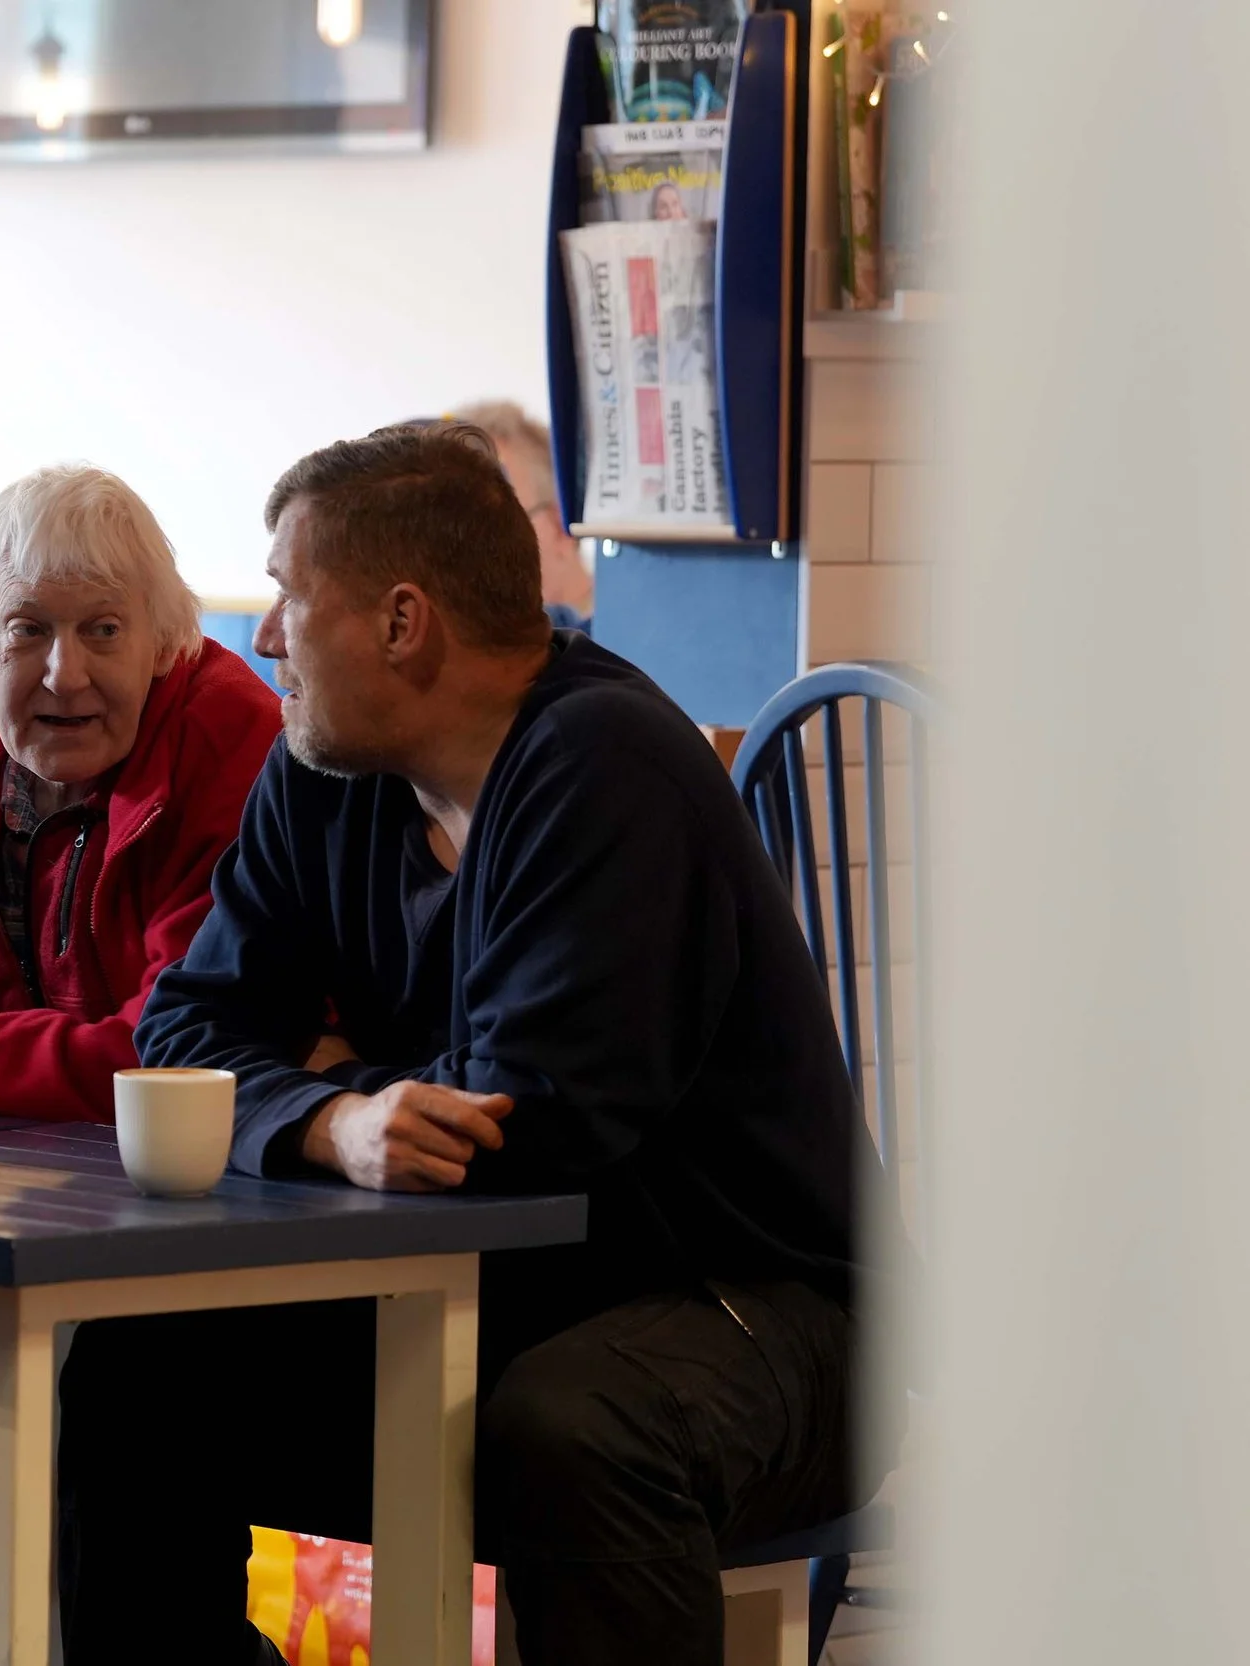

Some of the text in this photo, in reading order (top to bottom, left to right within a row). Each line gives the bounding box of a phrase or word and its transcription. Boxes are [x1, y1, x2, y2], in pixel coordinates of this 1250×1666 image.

[688, 27, 713, 41] ART
[668, 400, 687, 513] Cannabis
[691, 426, 708, 514] factory
